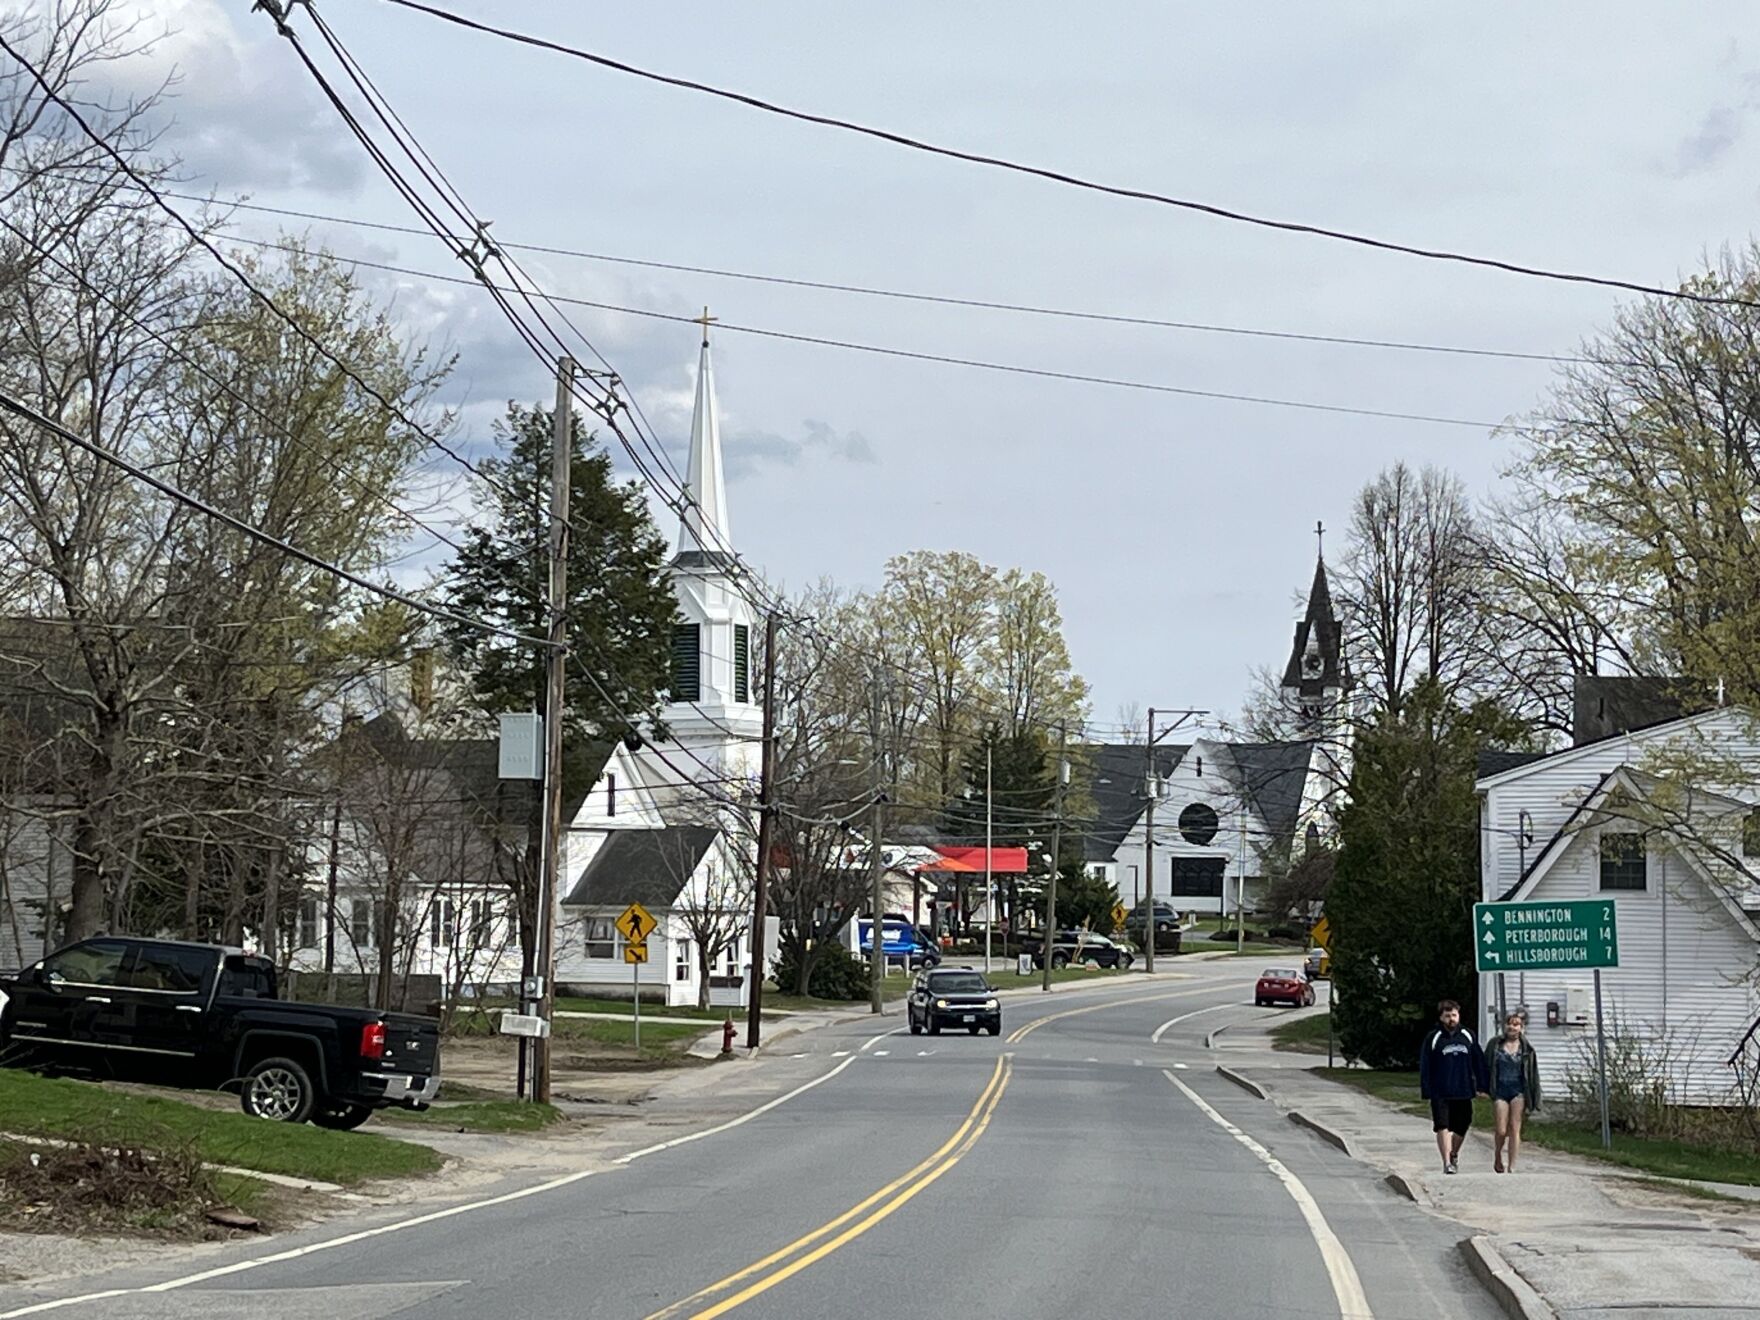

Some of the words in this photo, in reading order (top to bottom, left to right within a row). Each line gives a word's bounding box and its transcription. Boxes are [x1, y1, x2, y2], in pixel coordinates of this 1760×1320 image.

[1504, 908, 1572, 924] BENNINGTON
[1602, 907, 1610, 921] 2
[1505, 928, 1588, 944] PETERBOROUGH
[1600, 927, 1611, 940] 14
[1506, 947, 1588, 963] HILLSBOROUGH
[1605, 946, 1612, 960] 7
